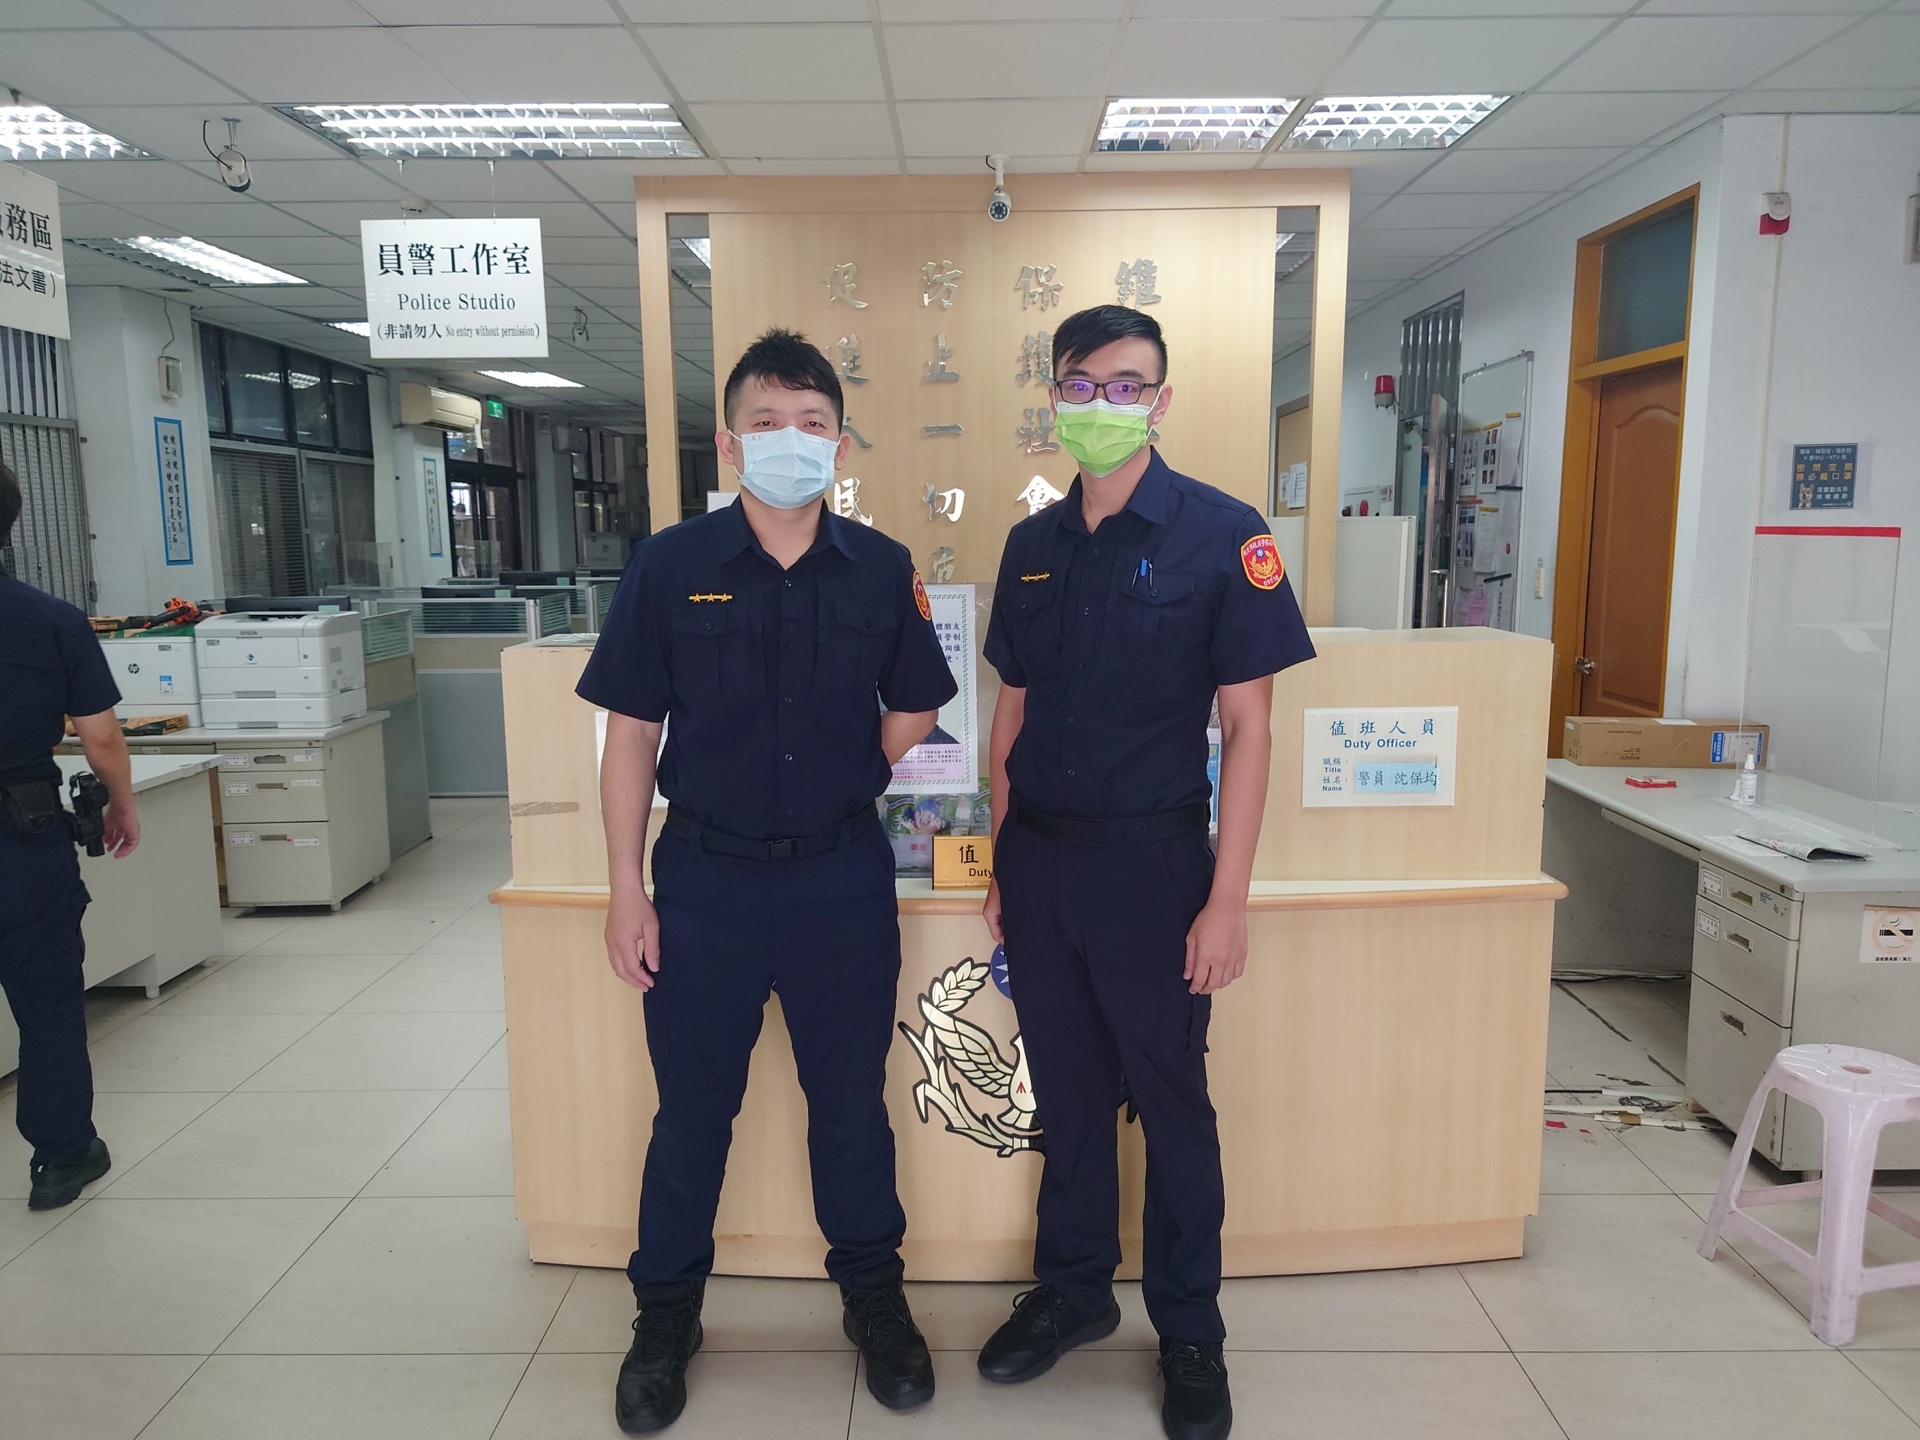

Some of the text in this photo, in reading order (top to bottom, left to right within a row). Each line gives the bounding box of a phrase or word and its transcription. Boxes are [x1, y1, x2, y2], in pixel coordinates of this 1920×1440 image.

[0, 202, 53, 251] 務區
[378, 243, 531, 276] 員警工作室
[397, 293, 516, 311] Police Studio
[377, 323, 442, 340] (非請勿入
[446, 325, 454, 337] No
[456, 326, 473, 338] entry
[475, 325, 499, 337] without
[1329, 718, 1435, 737] 值班人員
[1344, 738, 1418, 750] Duty Officer
[1358, 771, 1385, 786] 警員
[959, 844, 979, 864] 值
[968, 868, 993, 879] Duty
